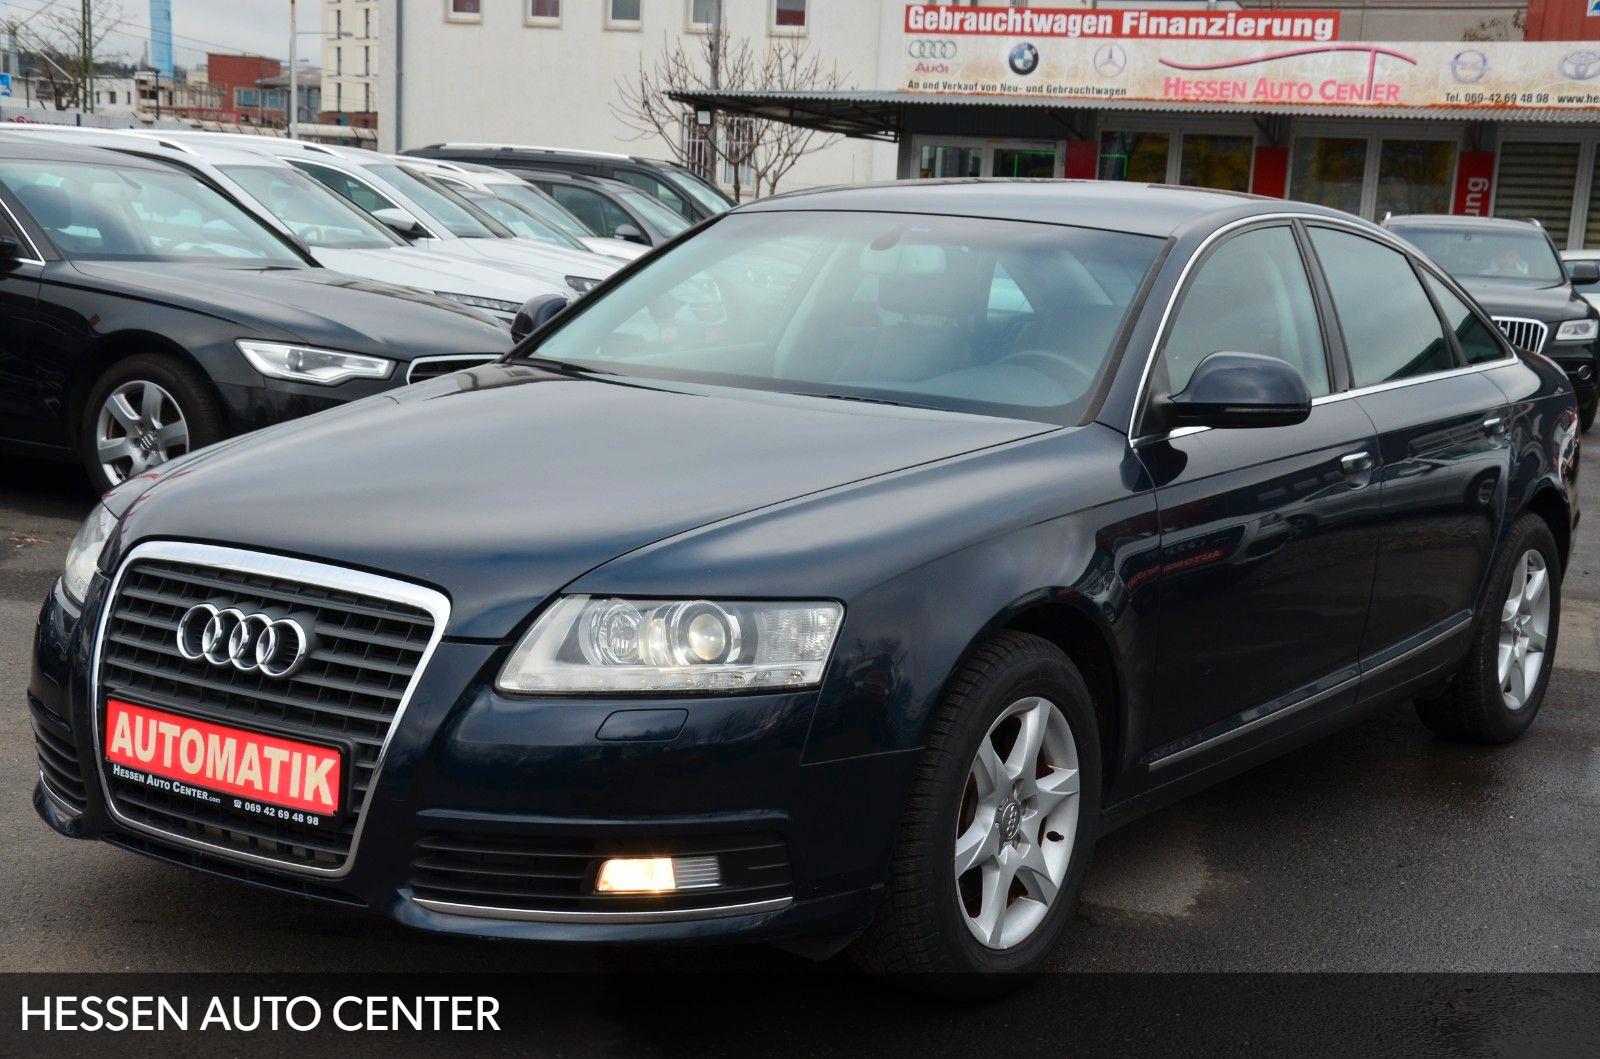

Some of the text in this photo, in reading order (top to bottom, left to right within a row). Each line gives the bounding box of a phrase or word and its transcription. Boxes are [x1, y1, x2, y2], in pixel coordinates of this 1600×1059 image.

[908, 5, 1334, 41] Gebrauchtwagen Finanzierung
[908, 80, 1127, 97] An und Verkauf von Neu- und Gebrauchtwagen
[1163, 76, 1401, 101] HESSEN AUTO CENTER
[1445, 92, 1461, 103] Tel.
[1464, 93, 1501, 103] 069-42
[1504, 93, 1517, 103] 69
[1520, 93, 1534, 104] 48
[1536, 93, 1549, 104] 98
[110, 711, 336, 806] AUTOMATIK
[244, 802, 319, 826] 069 42 69 48 98
